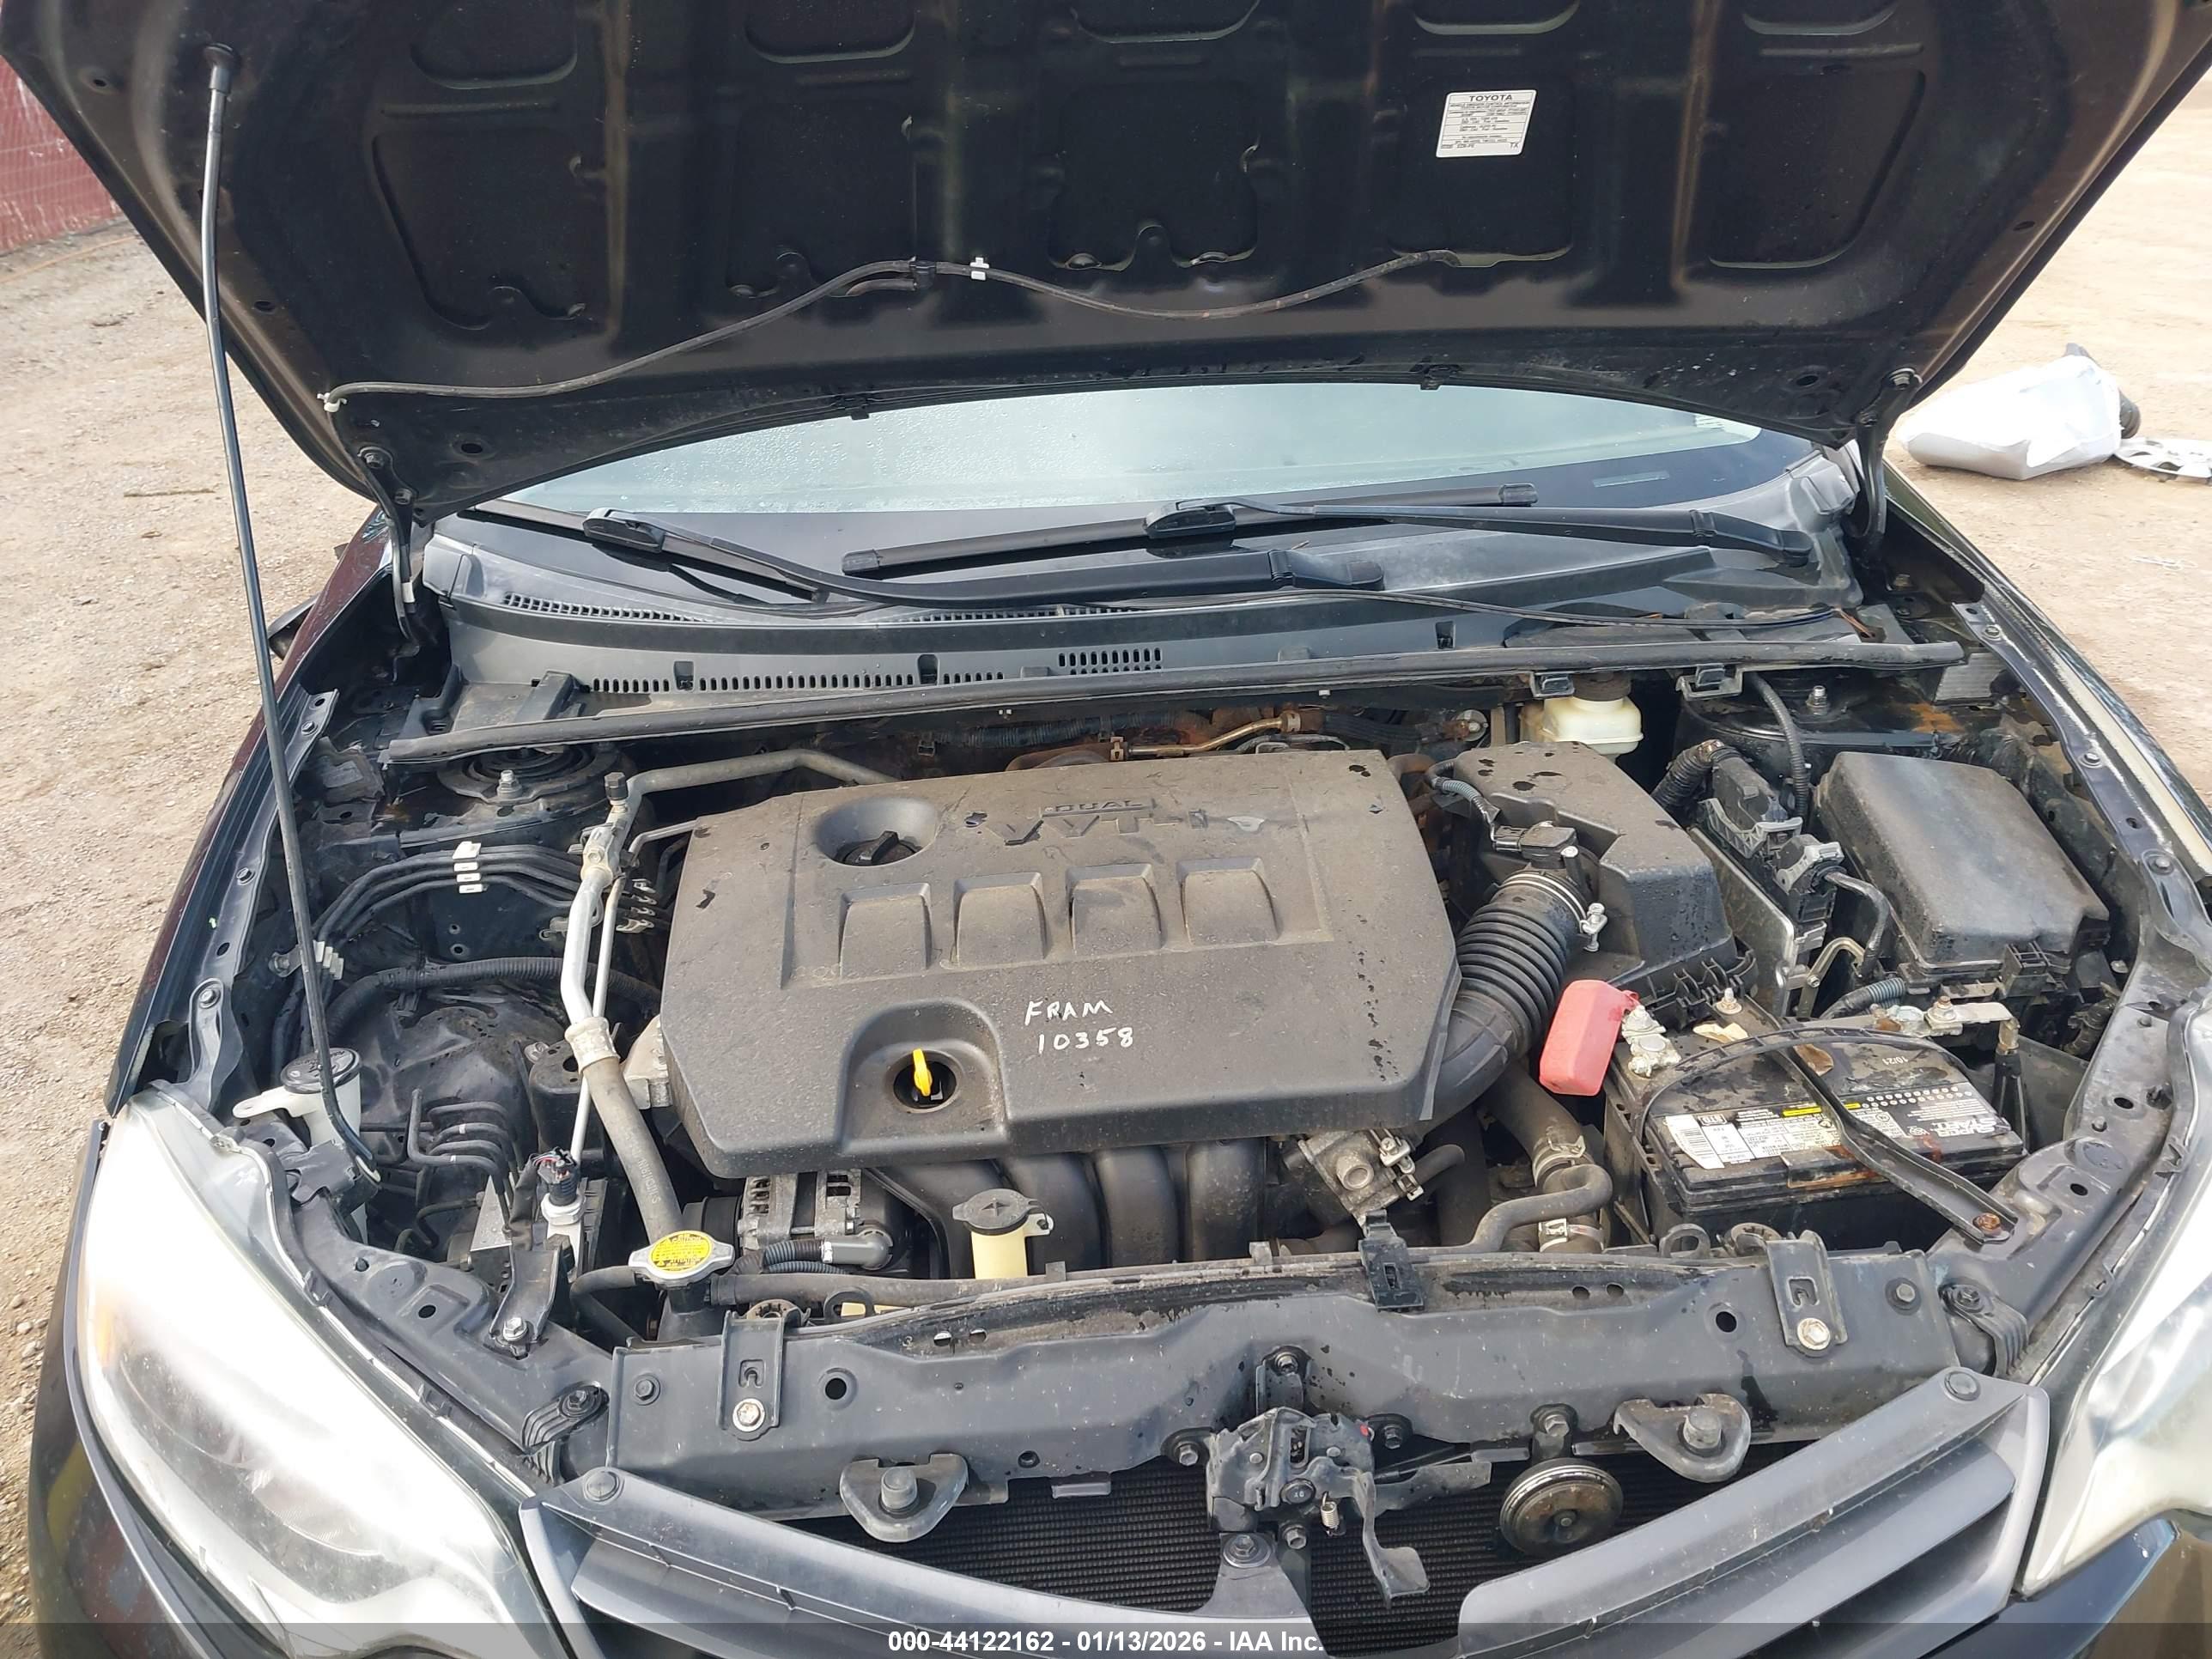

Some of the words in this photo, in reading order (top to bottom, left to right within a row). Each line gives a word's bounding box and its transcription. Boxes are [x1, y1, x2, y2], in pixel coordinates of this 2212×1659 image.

[1469, 94, 1513, 102] TOYOTA
[1054, 799, 1143, 813] DUAL
[1024, 1000, 1114, 1026] FRAM
[1038, 1026, 1134, 1055] 10358
[1881, 1055, 1909, 1066] 10/21
[1936, 1125, 1996, 1138] SUPER
